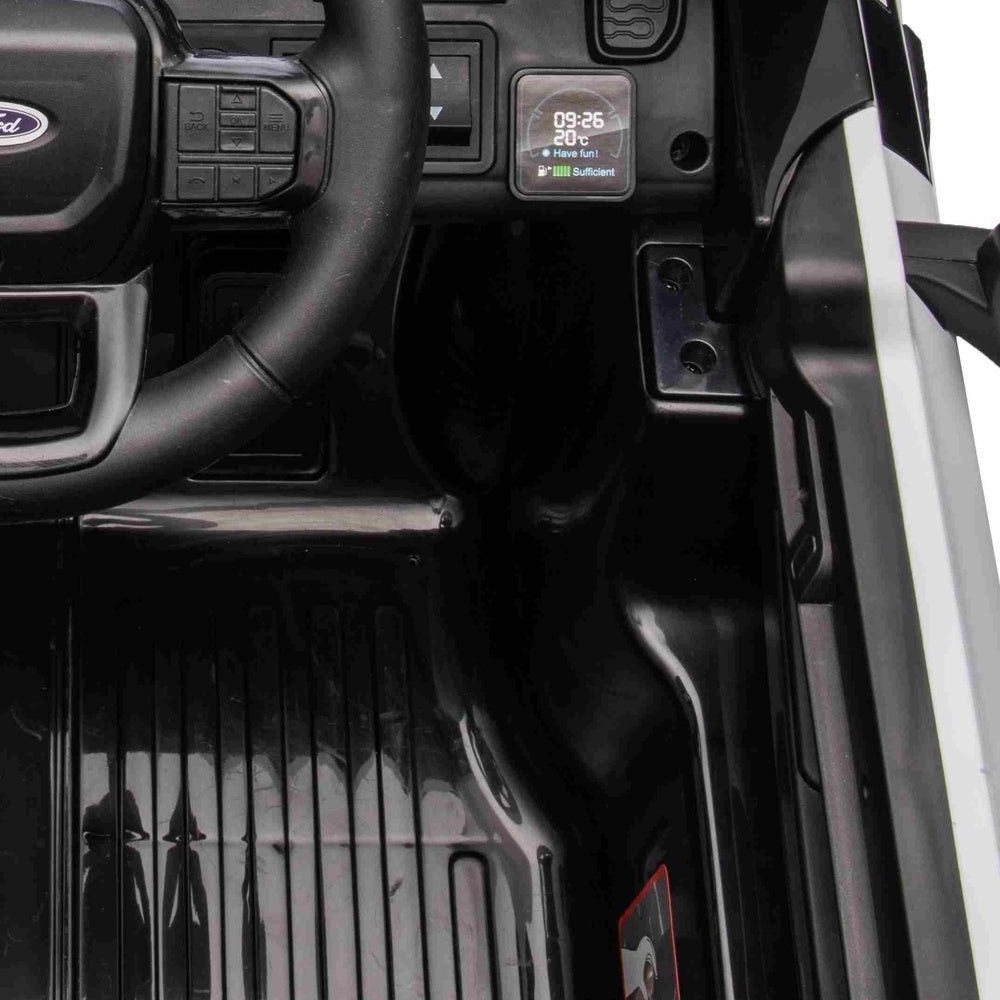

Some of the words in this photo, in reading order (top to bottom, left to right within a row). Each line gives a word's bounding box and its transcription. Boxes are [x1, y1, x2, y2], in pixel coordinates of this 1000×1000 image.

[553, 111, 605, 128] 09:26
[553, 149, 578, 158] Have
[579, 149, 598, 158] fun!
[572, 167, 615, 177] Sufficient
